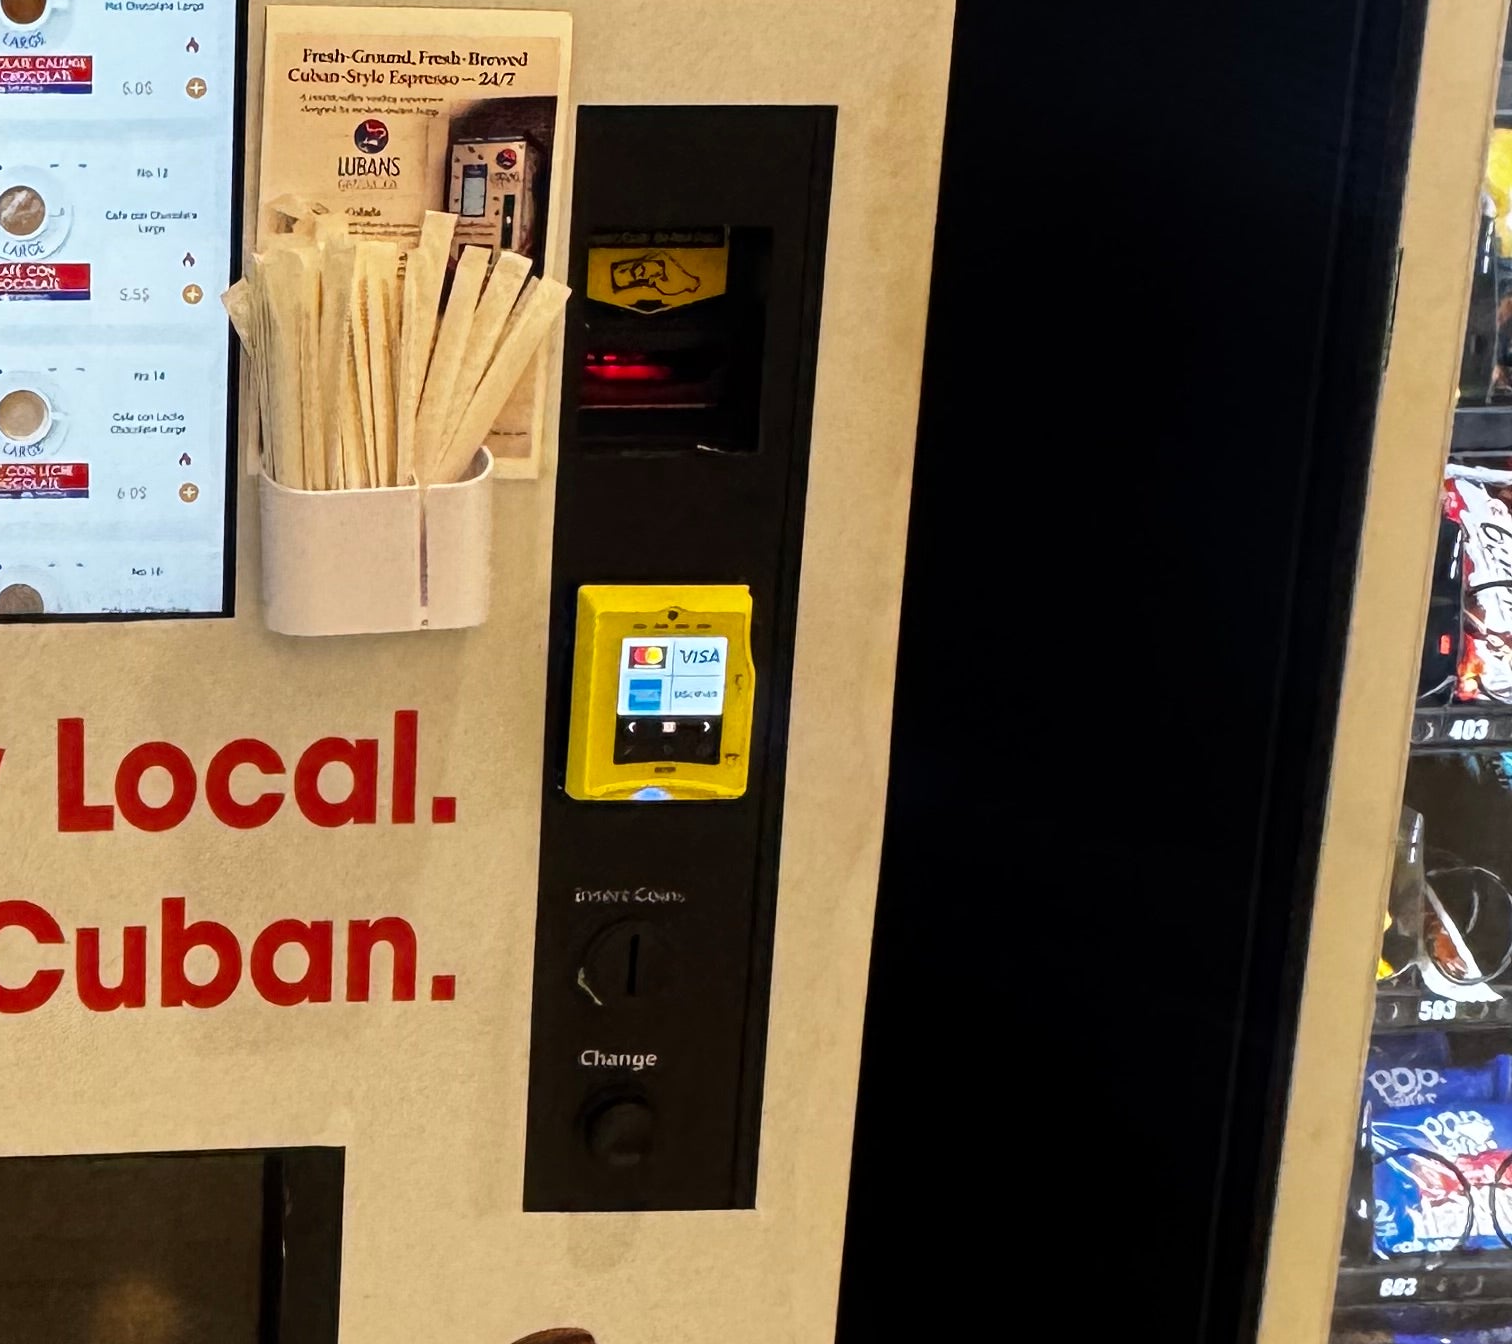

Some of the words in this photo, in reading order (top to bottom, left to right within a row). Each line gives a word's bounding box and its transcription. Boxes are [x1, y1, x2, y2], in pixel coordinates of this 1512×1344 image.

[337, 156, 401, 177] LUBANS
[679, 648, 720, 665] VISA
[1448, 719, 1490, 741] 403
[57, 709, 457, 833] Local.
[579, 1050, 658, 1071] Change
